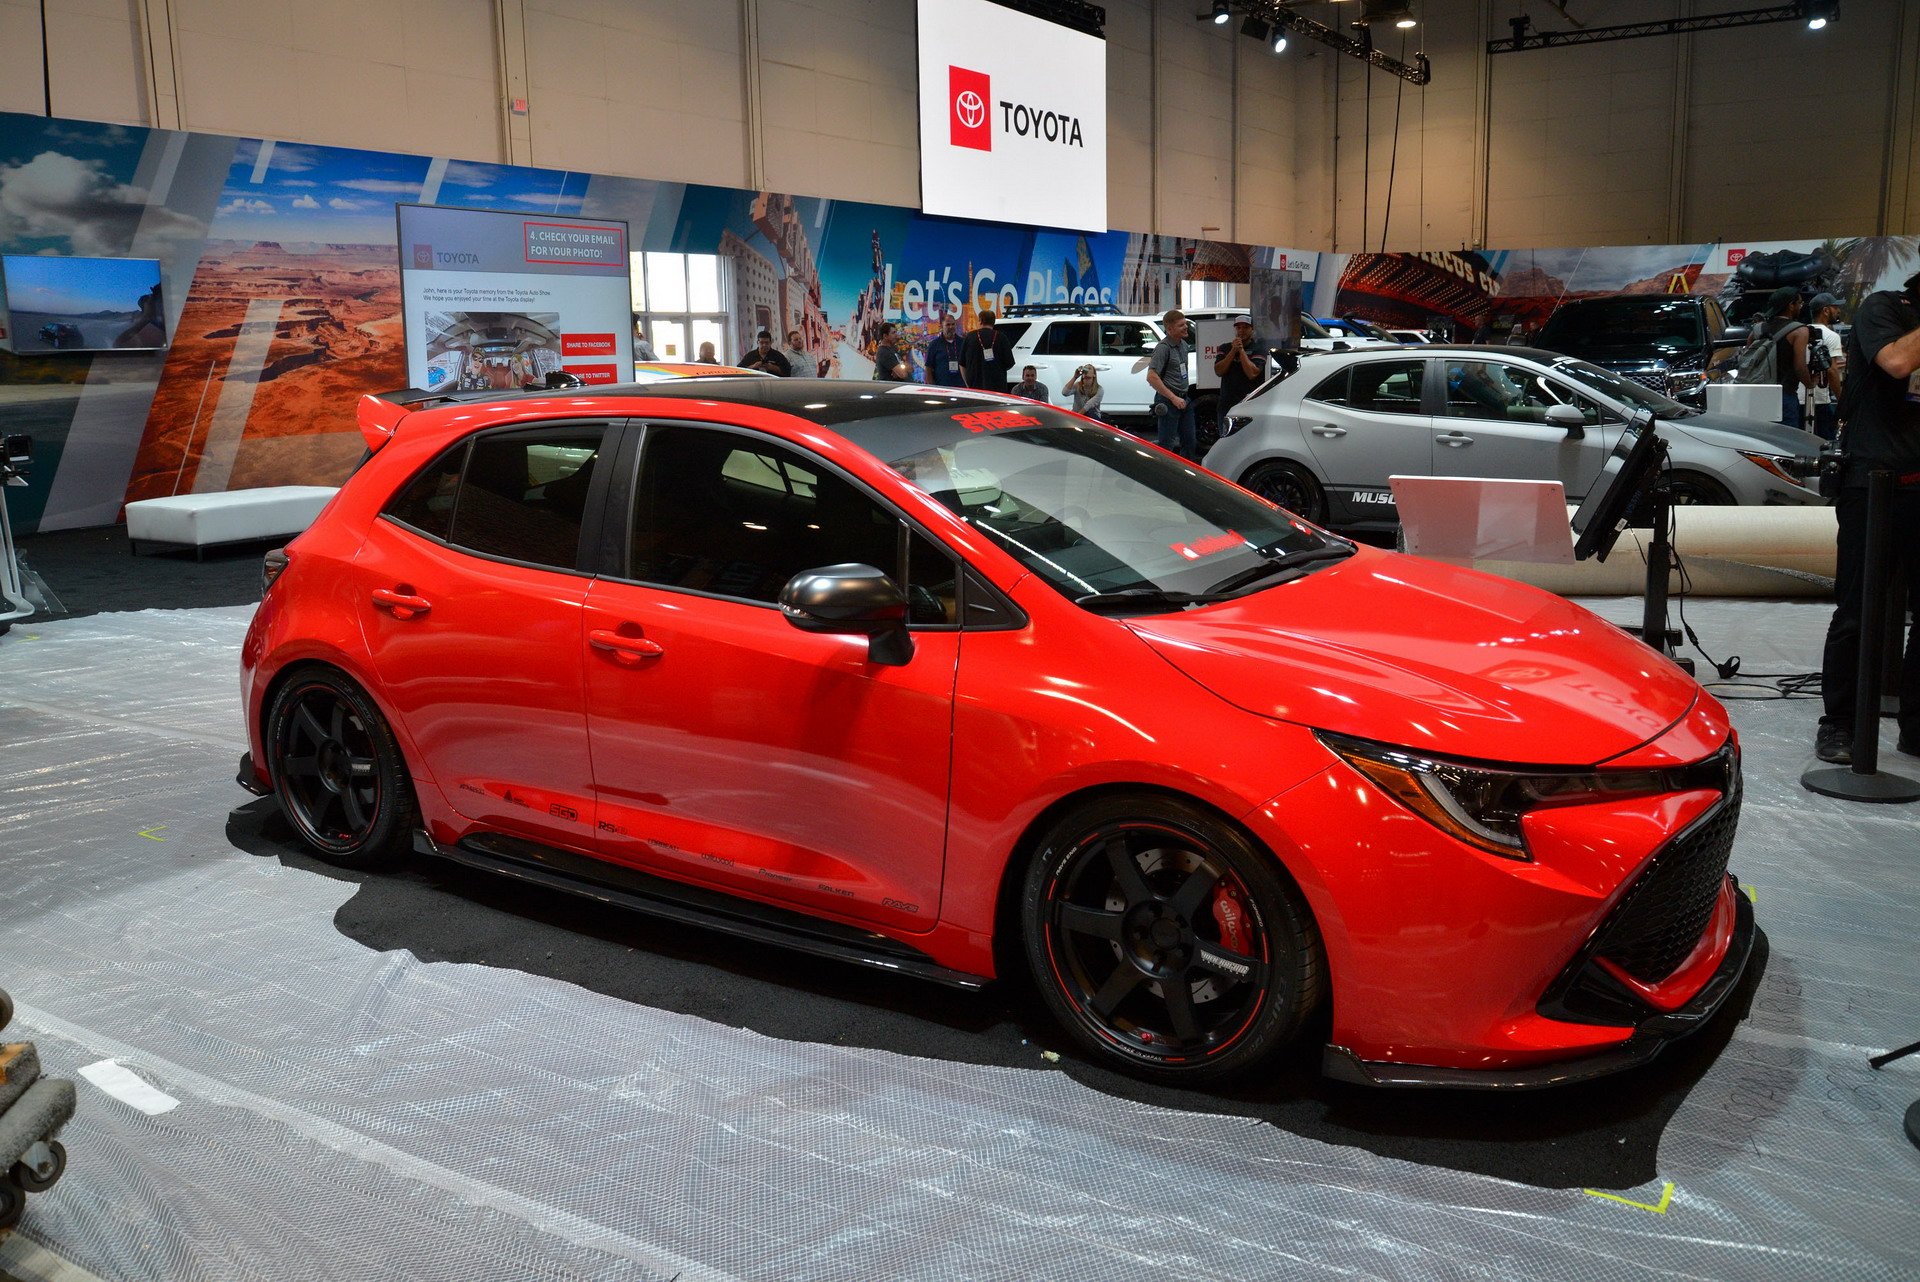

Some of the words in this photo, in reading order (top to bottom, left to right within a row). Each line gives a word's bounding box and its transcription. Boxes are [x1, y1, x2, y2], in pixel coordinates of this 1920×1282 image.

[1000, 101, 1083, 148] TOYOTA
[530, 231, 538, 240] 4.
[539, 231, 567, 242] CHECK
[567, 233, 590, 244] YOUR
[591, 234, 615, 245] EMAIL
[437, 251, 479, 264] TOYOTA
[531, 245, 548, 255] FOR
[548, 246, 571, 257] YOUR
[572, 248, 603, 258] PHOTO!
[464, 288, 478, 296] Toyota
[883, 263, 963, 321] Let's
[973, 267, 1018, 319] Go
[1025, 269, 1112, 315] Places
[960, 417, 1043, 433] STREET
[758, 867, 793, 882] Pioneer
[818, 884, 855, 897] FALKEN
